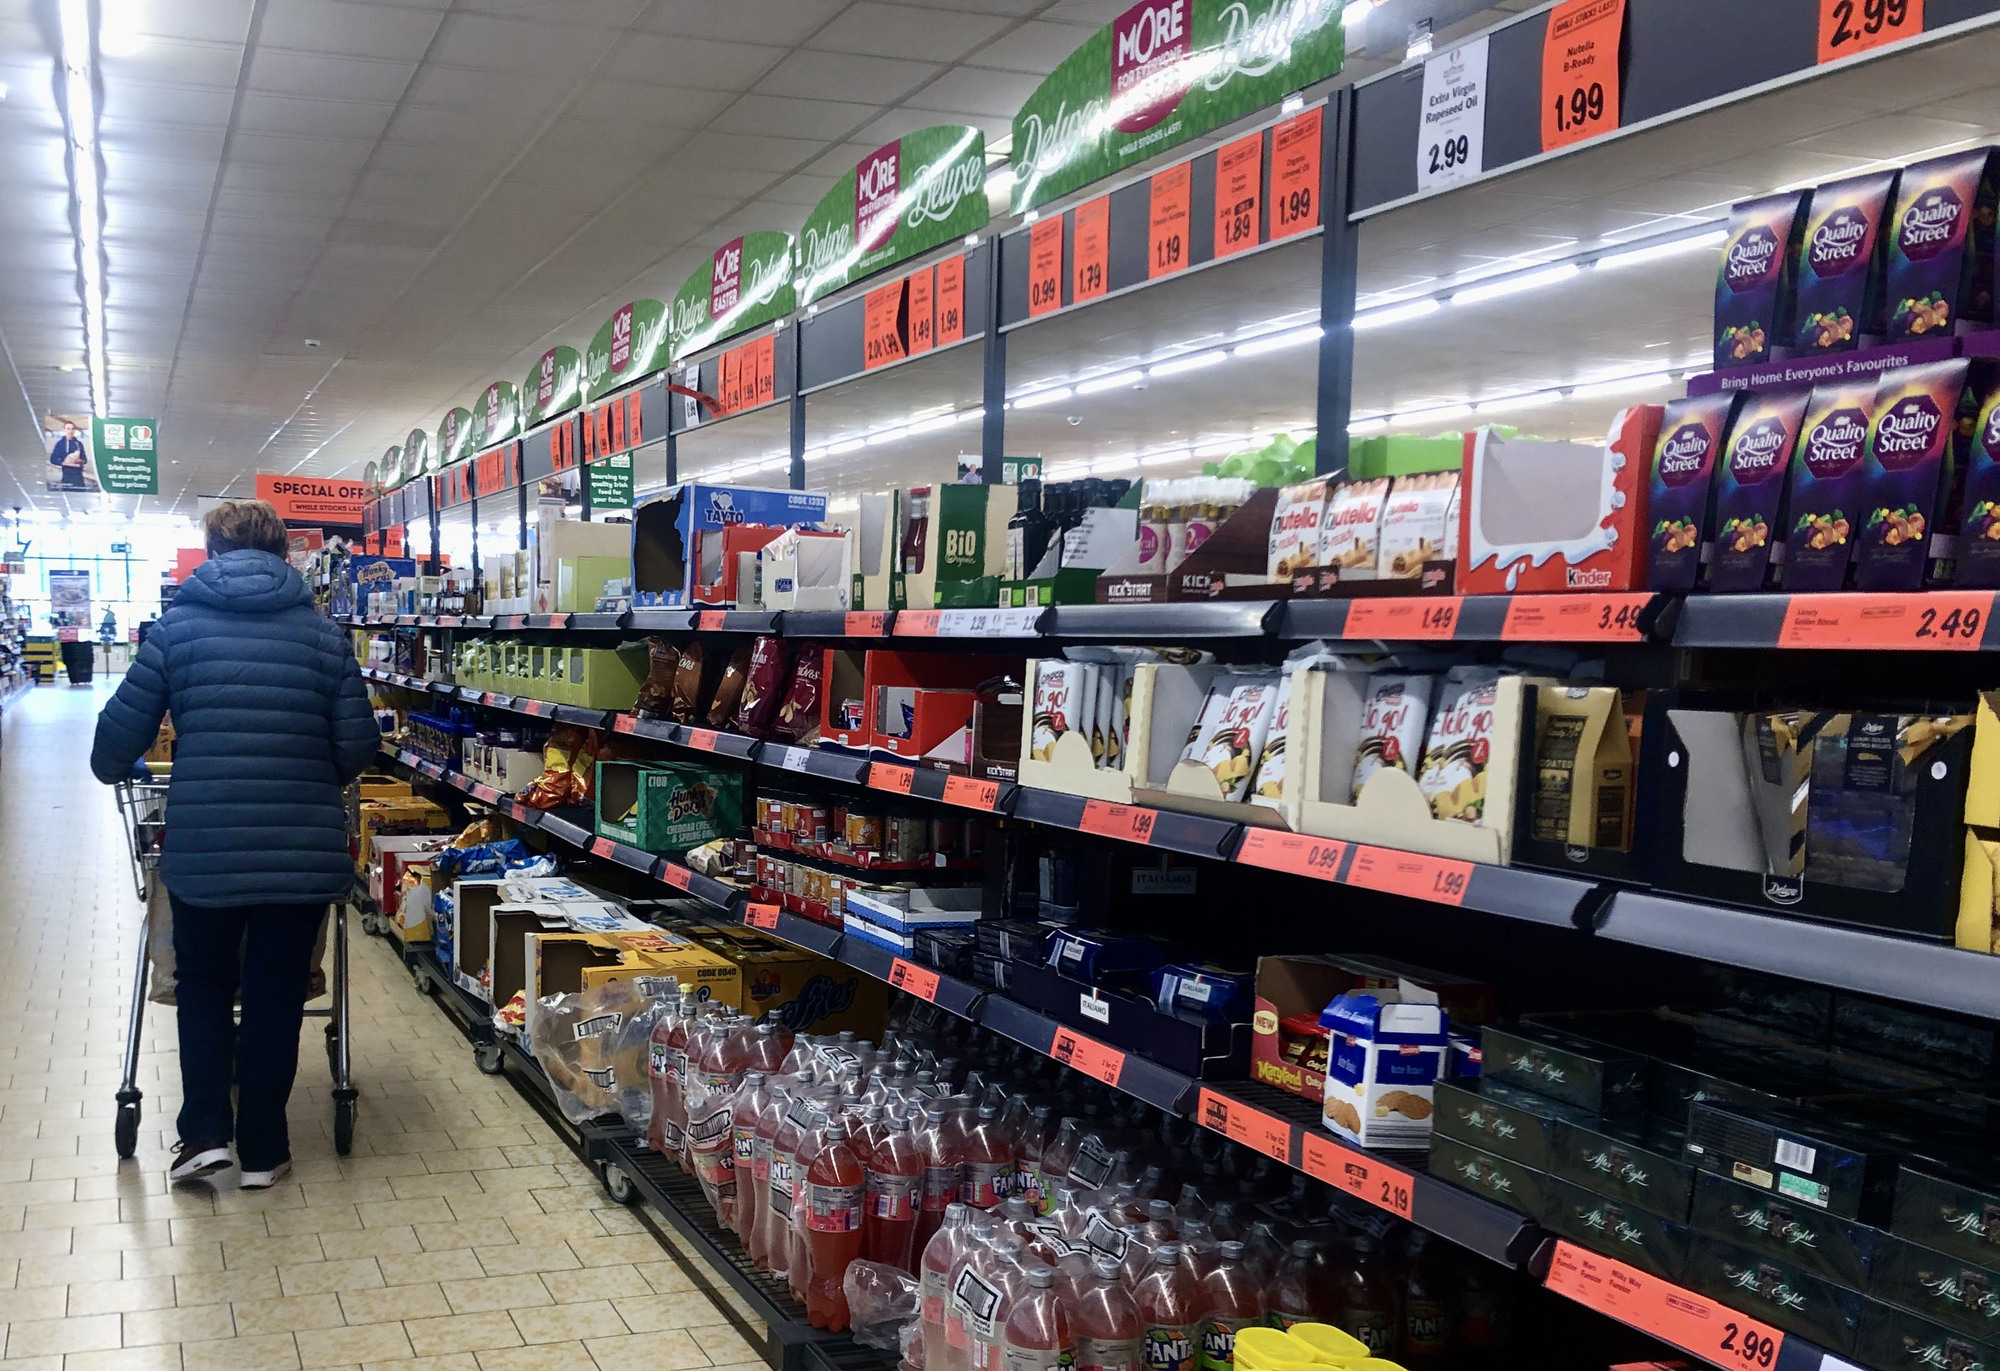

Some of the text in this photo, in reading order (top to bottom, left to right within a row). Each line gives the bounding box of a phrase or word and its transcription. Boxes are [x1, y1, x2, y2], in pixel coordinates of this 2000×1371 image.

[1575, 7, 1597, 25] STOCKS
[1831, 0, 1908, 47] 2.99
[1118, 3, 1184, 68] MORE
[1566, 40, 1594, 58] Nutella
[1563, 54, 1596, 73] B-Ready
[1117, 70, 1136, 89] FOR
[1430, 82, 1476, 107] Extra Virgin
[1555, 82, 1604, 132] 1.99
[1426, 95, 1478, 124] Rapeseed Oil
[1137, 129, 1163, 150] STOCKS
[1428, 134, 1468, 174] 2.99
[859, 155, 896, 200] MORE
[907, 156, 982, 228] Deluxe
[1280, 188, 1310, 226] 1.99
[1903, 202, 1962, 228] Quality
[1225, 214, 1250, 244] 1.89
[1813, 220, 1868, 246] Quality
[1904, 225, 1950, 246] Street
[1158, 234, 1180, 268] 1.19
[1729, 239, 1778, 260] Quality
[1813, 243, 1856, 263] Street
[714, 248, 740, 282] MORE
[1729, 261, 1768, 278] Street
[712, 288, 738, 314] EASTER
[1032, 278, 1055, 306] 0.99
[614, 312, 632, 340] MORE
[673, 294, 708, 341] Deluxe
[942, 308, 958, 334] 1.99
[912, 318, 930, 343] 1.49
[1721, 354, 1909, 390] Bring Home Everyone's Favourites
[1810, 424, 1868, 447] Quality
[1878, 412, 1940, 434] Quality
[1662, 436, 1710, 458] Quality
[1734, 432, 1786, 454] Quality
[1810, 444, 1856, 462] Street
[1878, 434, 1928, 452] Street
[126, 465, 151, 473] quality
[1663, 458, 1701, 473] Street
[1735, 454, 1776, 470] Street
[591, 473, 618, 481] Sourcing
[273, 482, 364, 499] SPECIAL OFF
[788, 496, 807, 504] CODE
[705, 510, 744, 524] TAYTO
[1272, 506, 1318, 534] nutella
[1324, 504, 1377, 530] nutella
[1568, 568, 1611, 586] kinder
[1422, 606, 1454, 629] 1.49
[1598, 605, 1642, 630] 3.49
[1916, 608, 1980, 638] 2.49
[1045, 686, 1068, 713] go!
[1238, 701, 1265, 726] go!
[1378, 704, 1408, 740] go!
[1466, 710, 1493, 742] go
[668, 788, 707, 808] Hunky
[667, 822, 696, 834] CHEDDAR
[1132, 813, 1150, 834] 1.99
[678, 831, 701, 842] SPRING
[1308, 846, 1338, 868] 0.99
[1136, 873, 1192, 884] ITALIAMO
[1434, 870, 1463, 896] 1.99
[1768, 882, 1798, 898] Deluxe
[697, 968, 736, 978] CODE 0040
[1182, 982, 1208, 995] ITALIAMO
[1082, 1001, 1107, 1016] ITALIAMO
[1256, 1016, 1276, 1030] NEW
[1256, 1059, 1302, 1087] Maryland
[1512, 1055, 1566, 1083] After Eight
[1460, 1110, 1517, 1140] After Eight
[1457, 1160, 1512, 1192] After Eight
[1584, 1152, 1648, 1186] After Eight
[1381, 1180, 1408, 1212] 2.19
[1577, 1208, 1643, 1245] After Eight
[1732, 1208, 1817, 1248] After Eight
[1943, 1212, 1989, 1237] After
[1560, 1249, 1572, 1259] Twix
[1582, 1260, 1597, 1271] Mars
[1580, 1270, 1602, 1284] Funsize
[1609, 1279, 1632, 1295] Funsize
[1612, 1270, 1642, 1289] Milky Way
[1920, 1277, 1966, 1302] After
[1724, 1269, 1806, 1311] After Eight
[1720, 1322, 1774, 1367] 2.99
[1905, 1344, 1952, 1370] After
